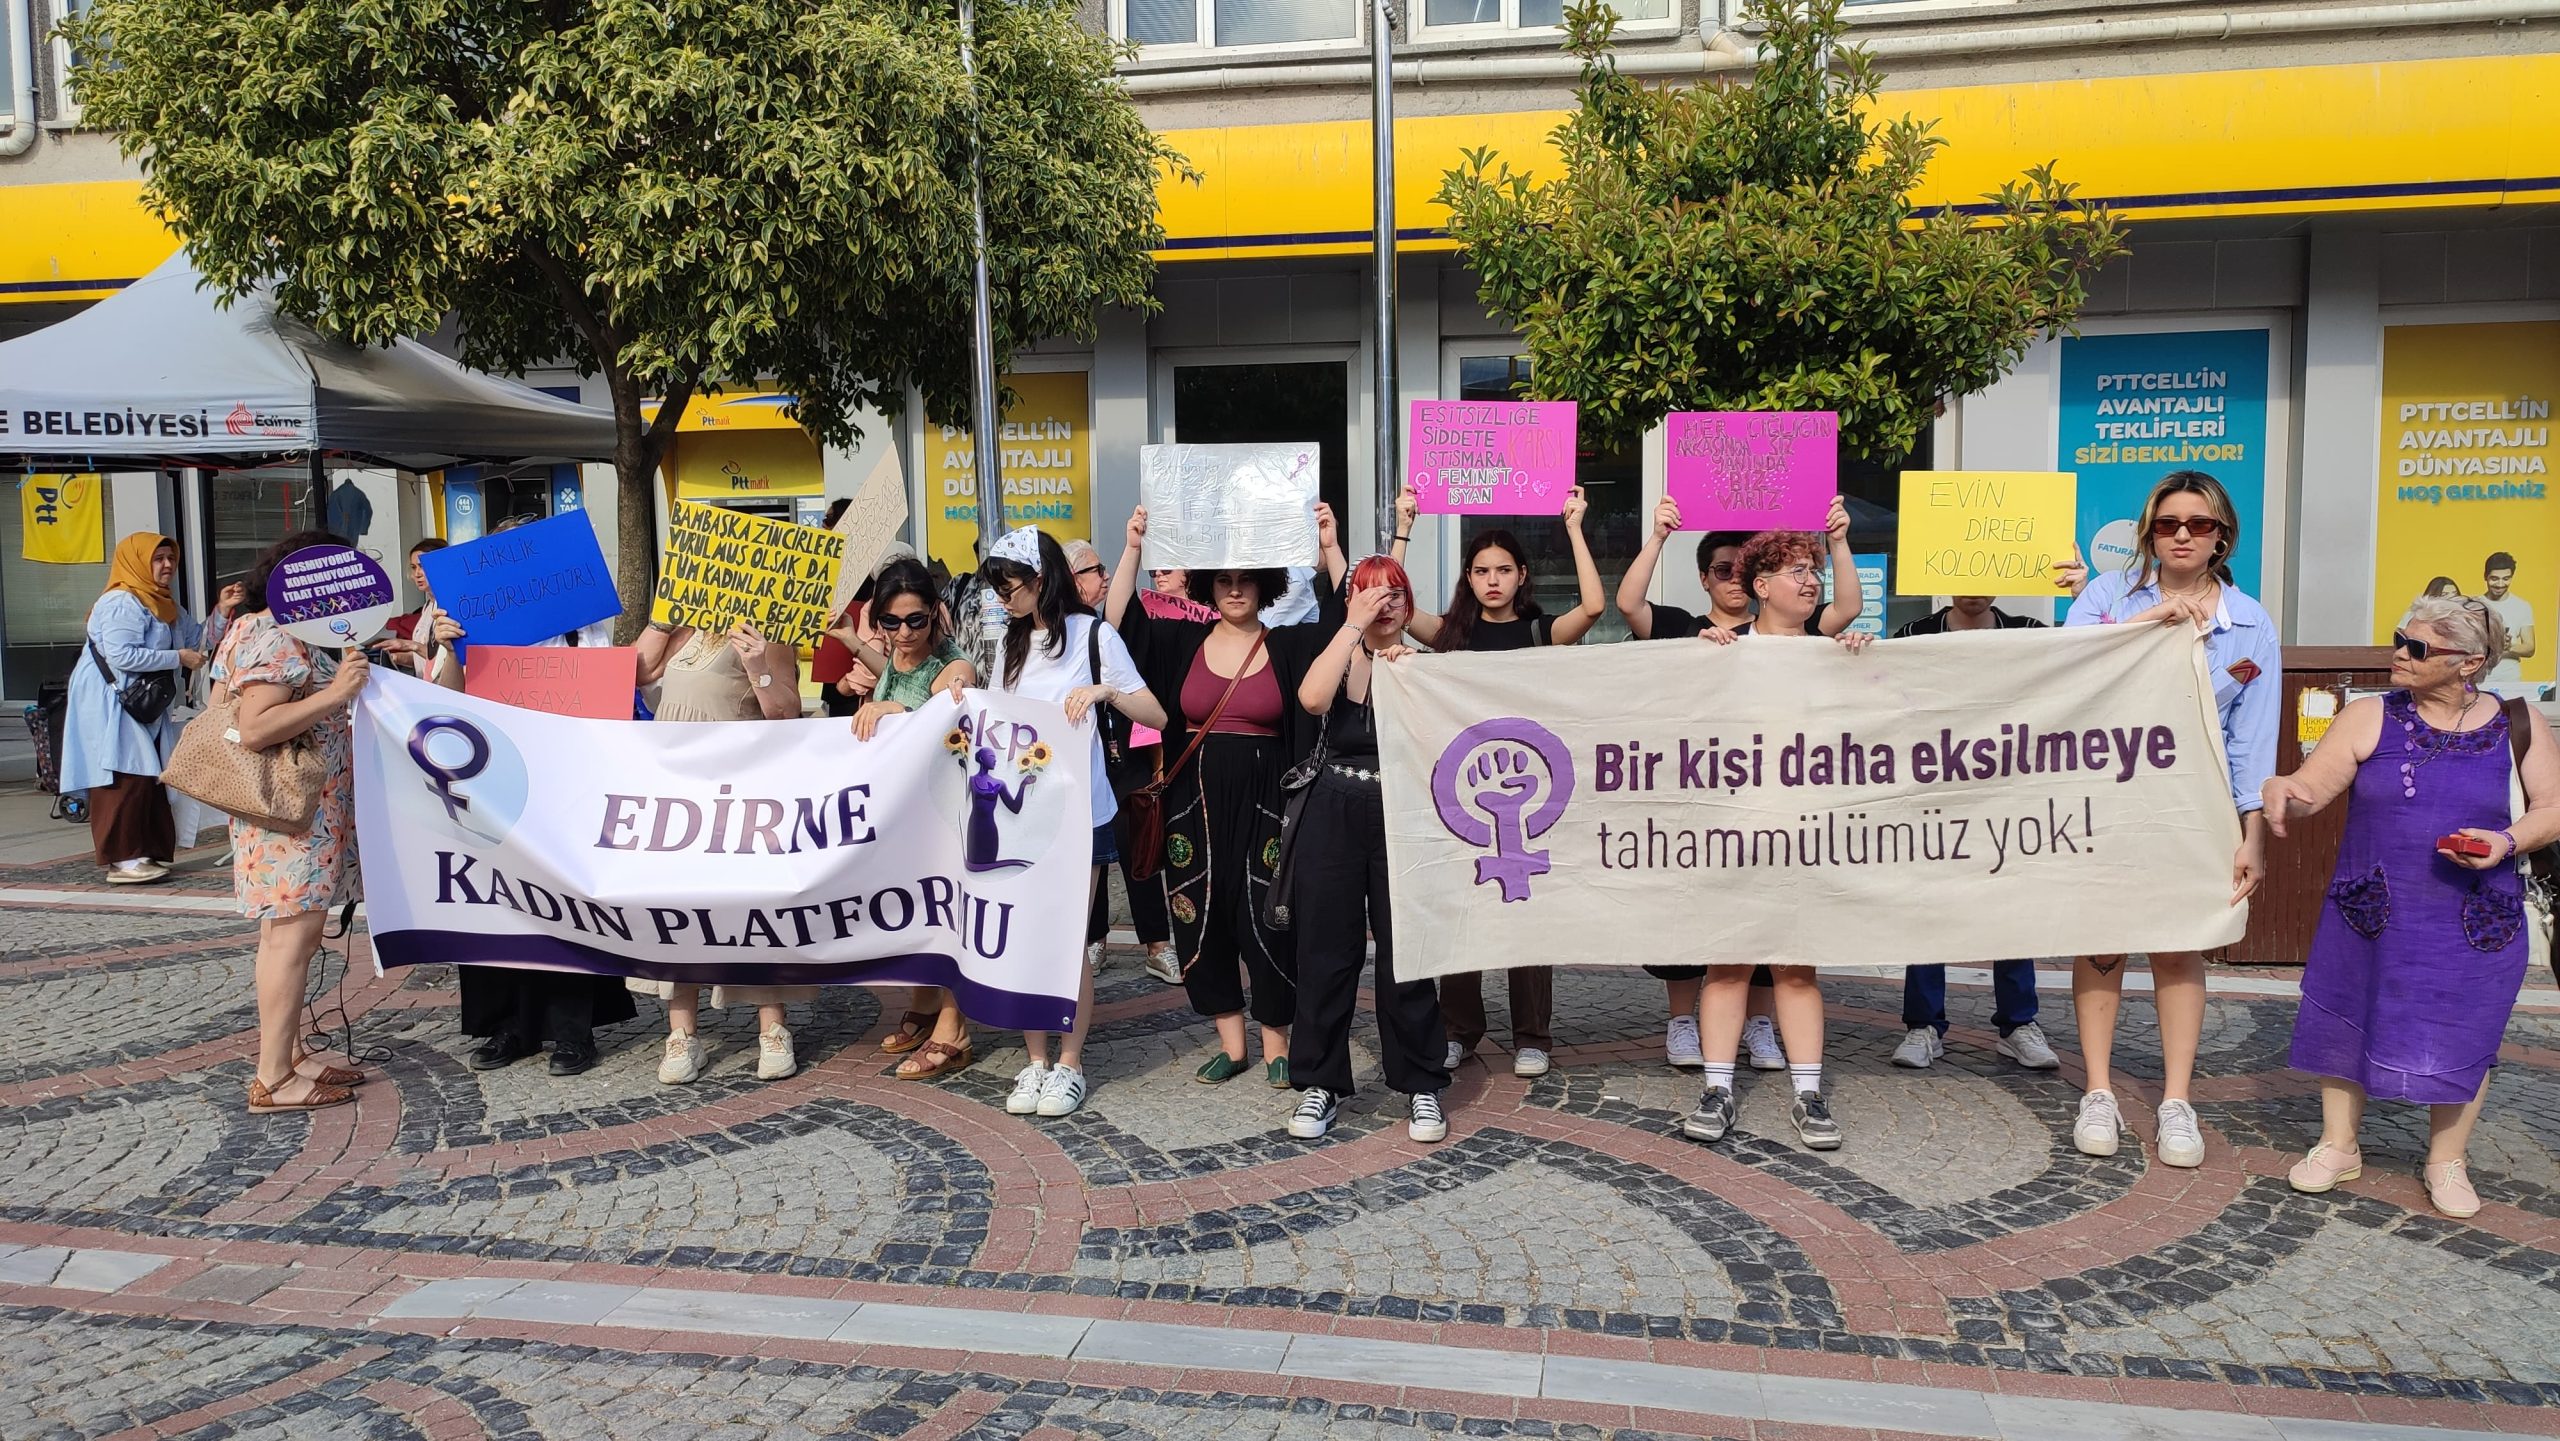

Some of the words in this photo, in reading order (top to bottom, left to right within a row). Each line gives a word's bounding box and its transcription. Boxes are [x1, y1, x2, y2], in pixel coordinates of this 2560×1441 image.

[2096, 366, 2227, 392] PTTCELL'İN
[2096, 395, 2225, 416] AVANTAJLI
[2399, 395, 2549, 423] PTTCELL'İN
[23, 406, 210, 438] BELEDİYESİ
[255, 414, 303, 428] Edirne
[942, 415, 1072, 443] PELL'İN
[1683, 418, 1729, 440] HER
[2094, 415, 2226, 440] TEKLİFLERİ
[2398, 427, 2548, 449] AVANTAJLI
[943, 448, 1072, 470] AVTAJLI
[2075, 442, 2118, 465] SİZİ
[2121, 440, 2245, 463] BEKLİYOR!
[2398, 453, 2546, 476] DÜNYASINA
[944, 473, 1073, 496] DÜASINA
[1448, 487, 1493, 506] İSYAN
[1929, 478, 2007, 509] EVİN
[2397, 485, 2442, 505] HOŞ
[2445, 479, 2546, 500] GELDİNİZ
[35, 486, 58, 526] Ptt
[1003, 500, 1073, 520] ELDİNİZ
[751, 521, 845, 560] ZİNCİRLERE
[1964, 516, 2035, 542] DİREĞİ
[283, 550, 358, 575] SUSMUYORUZ
[462, 537, 540, 576] LAİKLİK
[2096, 543, 2137, 556] FATURA
[284, 562, 366, 589] KORKMUYORUZ
[750, 547, 801, 578] OLSAK
[805, 558, 829, 582] DA
[282, 588, 313, 603] İTAAT
[701, 560, 777, 600] KADINLAR
[782, 575, 833, 609] ÖZGÜR
[657, 576, 709, 608] OLANA
[713, 590, 761, 620] KADAR
[765, 600, 801, 626] BEN
[800, 608, 827, 630] DE
[957, 708, 1039, 762] ekp
[1595, 740, 1663, 792] Bir
[1679, 733, 1764, 796] kişi
[1779, 732, 1896, 787] daha
[1911, 723, 2177, 783] eksilmeye
[593, 783, 877, 855] EDİRNE
[1597, 808, 1971, 870] tahammülümüz
[1985, 796, 2094, 875] yok!
[434, 850, 634, 942] KADIN
